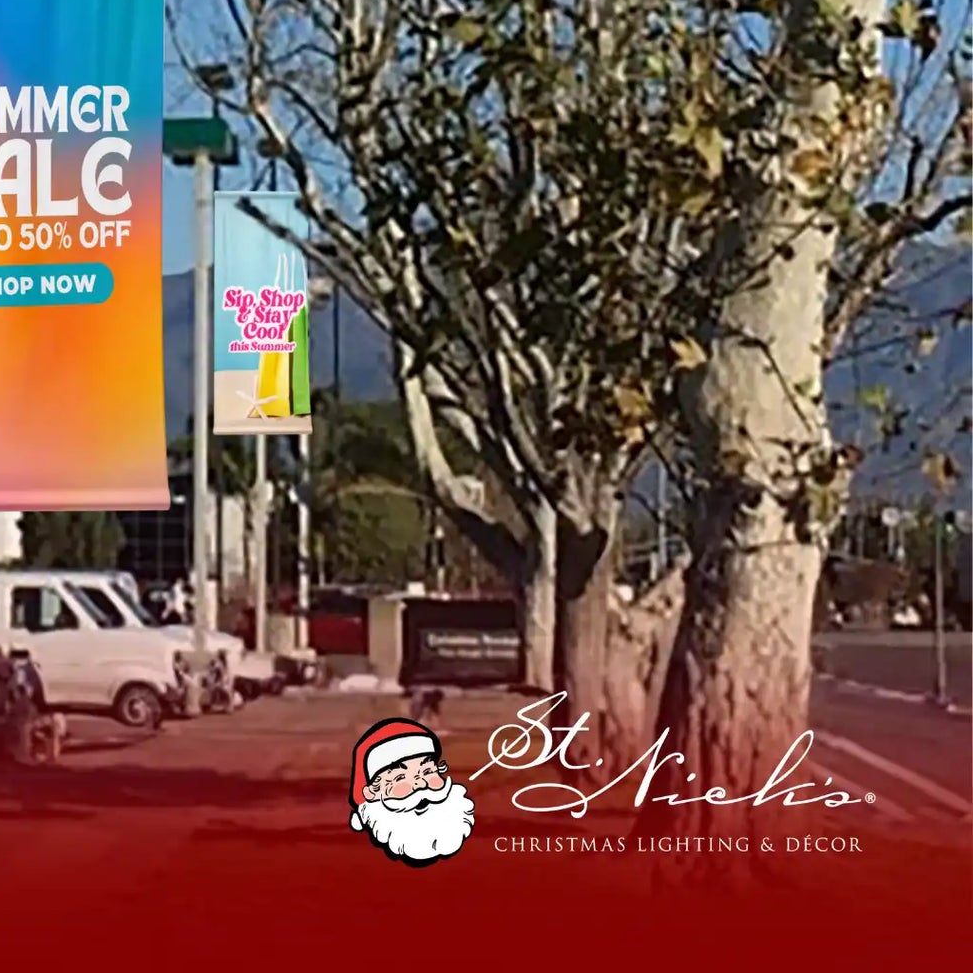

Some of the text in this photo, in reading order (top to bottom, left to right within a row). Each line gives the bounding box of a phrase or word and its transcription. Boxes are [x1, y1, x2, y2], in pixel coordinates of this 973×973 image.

[19, 221, 73, 251] 50%
[79, 220, 132, 249] OFF
[40, 274, 97, 295] NOW
[260, 289, 304, 313] Shop
[237, 306, 294, 331] & Stay
[243, 322, 286, 340] Cool
[230, 341, 296, 352] this Summer
